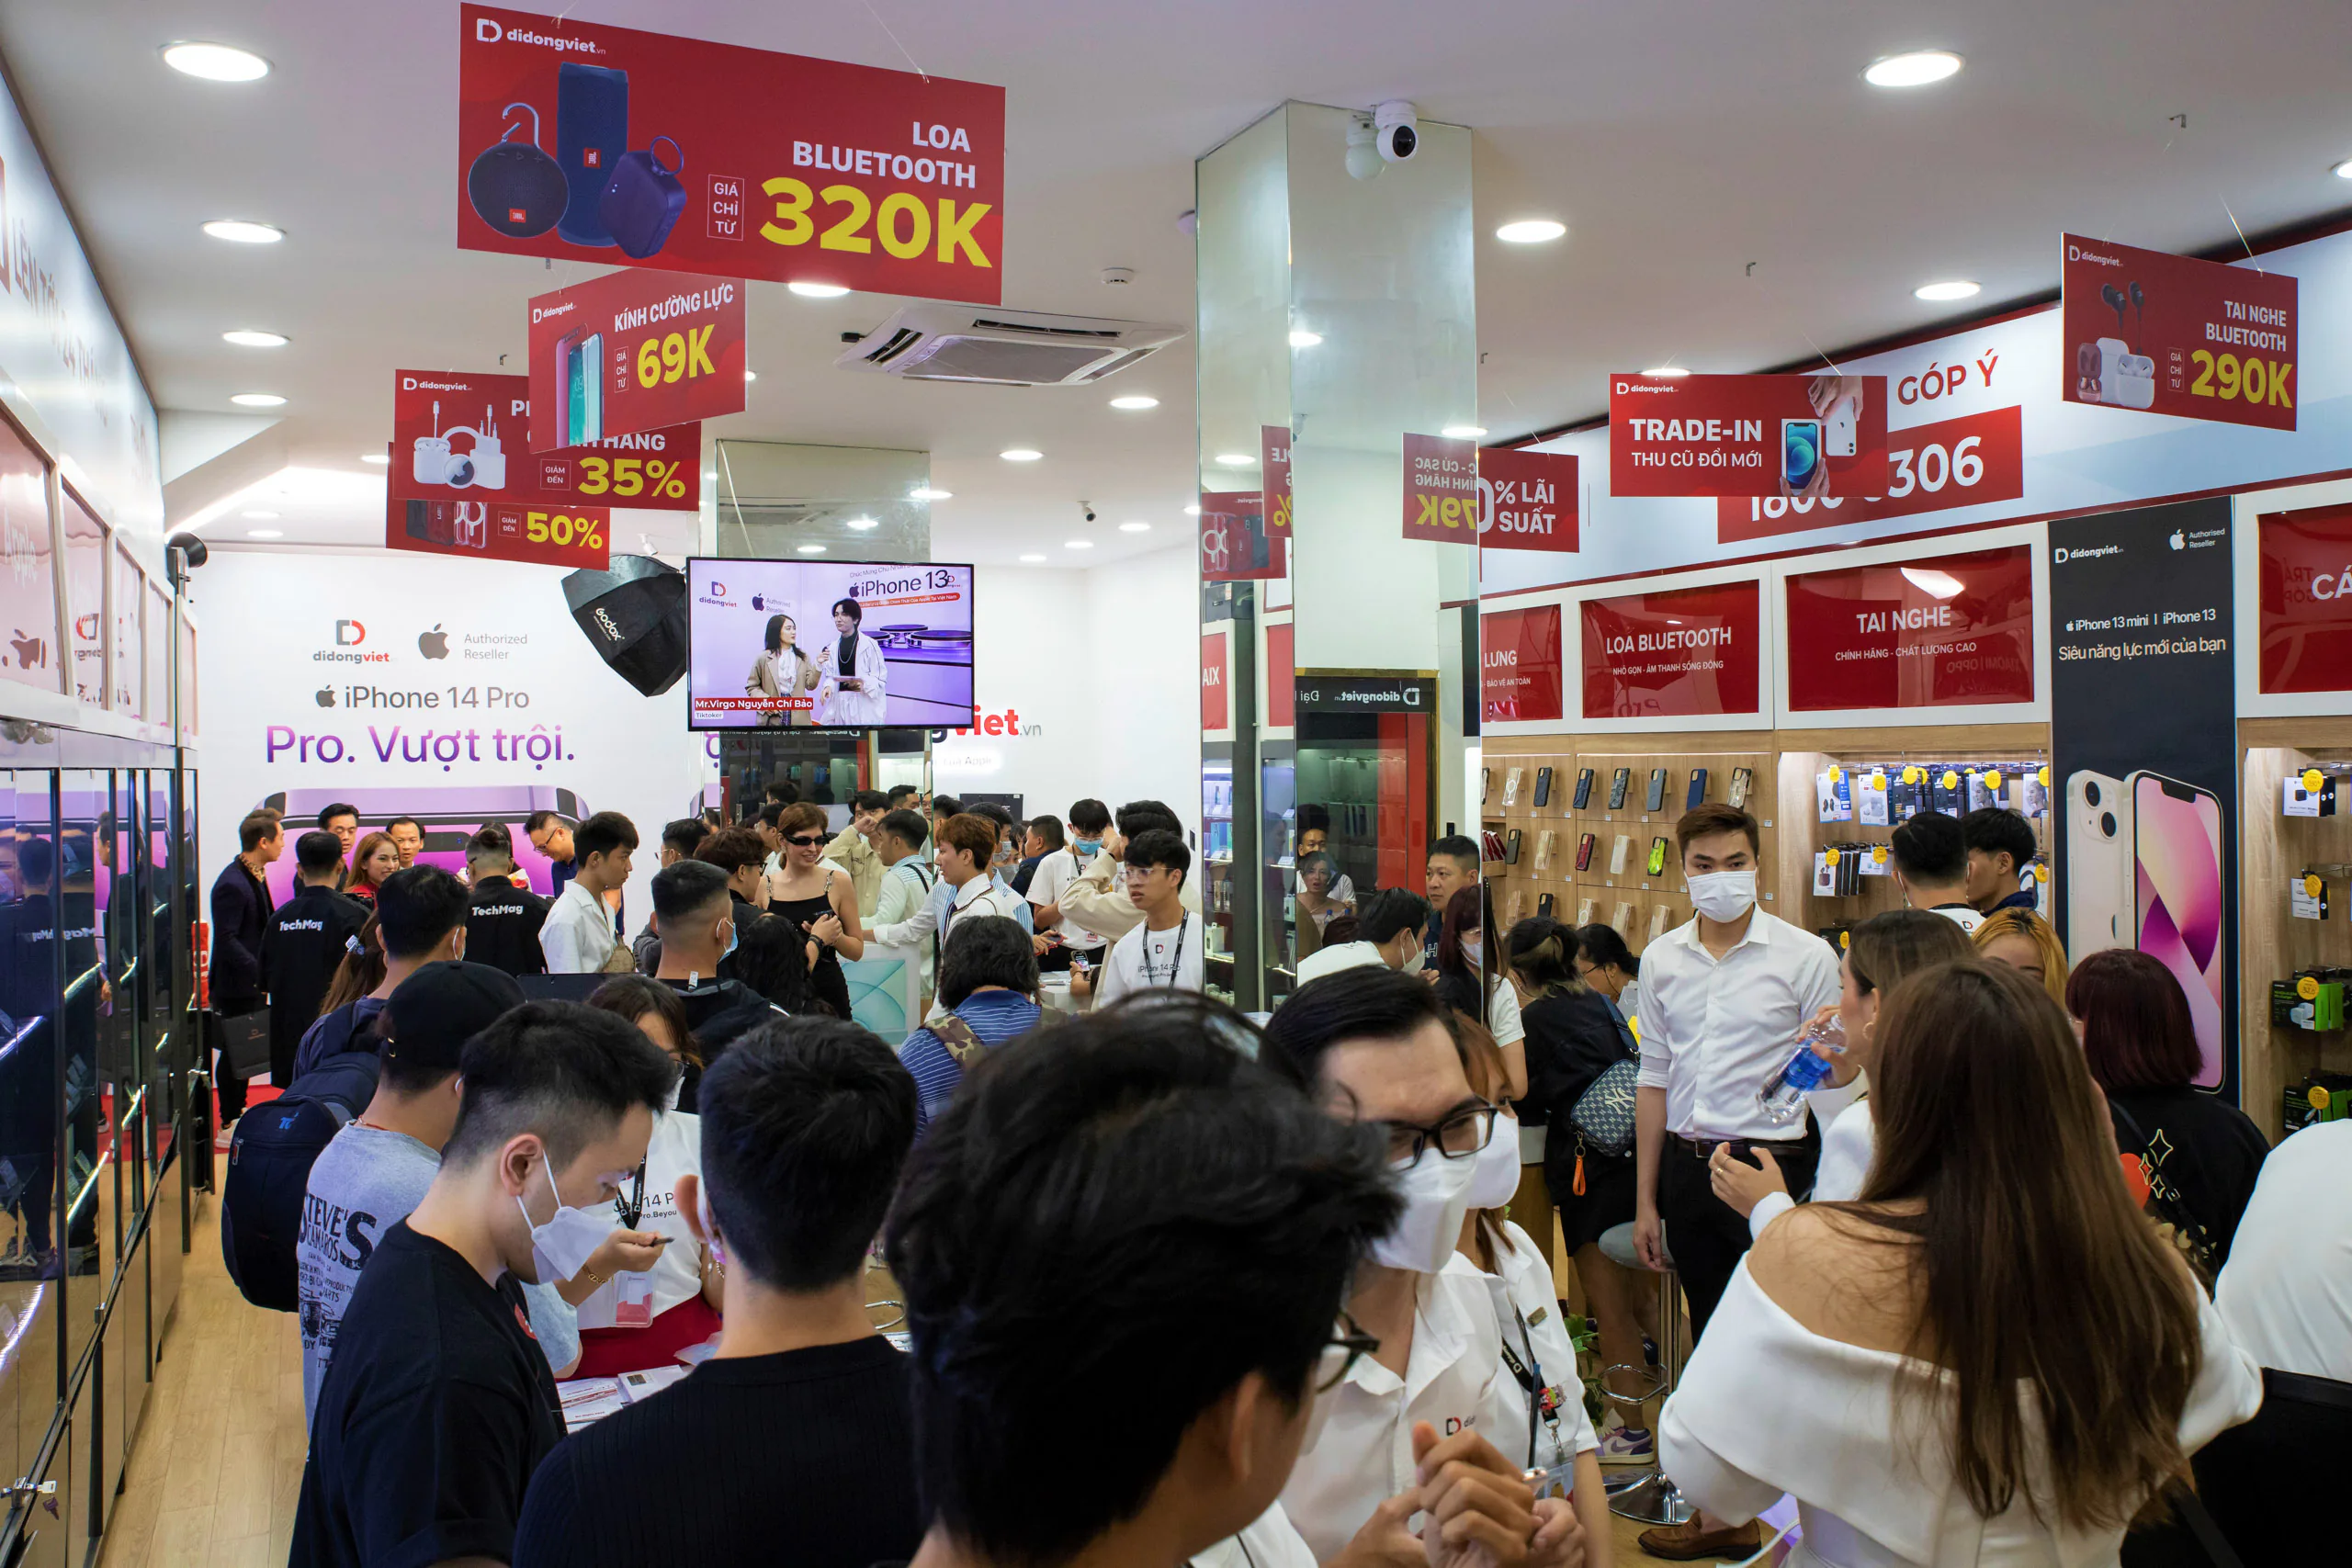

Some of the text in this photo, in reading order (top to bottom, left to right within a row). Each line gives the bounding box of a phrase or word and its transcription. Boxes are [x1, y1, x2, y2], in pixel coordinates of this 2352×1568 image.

[912, 121, 971, 152] LOA
[793, 141, 976, 189] BLUETOOTH
[714, 182, 739, 197] GIÁ
[713, 200, 739, 216] CHỈ
[715, 220, 737, 235] TỪ
[759, 176, 993, 268] 320K
[614, 283, 734, 333] KÍNH CƯỜNG LỰC
[2224, 300, 2287, 327] TAI NGHE
[2206, 321, 2287, 352] BLUETOOTH
[637, 323, 716, 389] 69K
[1897, 347, 2000, 406] GÓP Ý
[2191, 349, 2293, 409] 290K
[1629, 418, 1763, 443] TRADE-IN
[1632, 446, 1763, 468] THU CŨ ĐỔI MỚI
[1864, 435, 1984, 502] 306
[578, 457, 686, 499] 35%
[1521, 479, 1555, 504] LÃI
[526, 512, 604, 549] 50%
[1498, 506, 1555, 535] SUẤT
[2188, 528, 2226, 540] Authorised
[2188, 539, 2216, 549] Reseller
[861, 570, 949, 597] iPhone 13
[595, 607, 623, 641] Godox
[1856, 605, 1951, 634] TAI NGHE
[2075, 608, 2216, 631] iPhone 13 mini iPhone 13
[464, 634, 527, 645] Authorized
[1606, 626, 1732, 655] LOA BLUETOOTH
[1835, 649, 1862, 661] CHÍNH
[1863, 646, 1889, 660] HÃNG
[1895, 644, 1920, 658] CHẤT
[1921, 643, 1953, 657] LƯỢNG
[1955, 642, 1977, 654] CAO
[2058, 636, 2226, 661] Siêu năng lực mới của bạn
[464, 649, 510, 660] Reseller
[1484, 649, 1517, 669] LƯNG
[1612, 665, 1627, 676] NHỎ
[1628, 664, 1642, 678] GỌN
[1645, 662, 1657, 674] ÂM
[1657, 662, 1680, 673] THANH
[1681, 659, 1702, 671] SỐNG
[1702, 659, 1724, 671] ĐỘNG
[1498, 678, 1507, 688] VỆ
[1507, 678, 1514, 686] AN
[1515, 676, 1531, 686] TOÀN
[345, 685, 530, 708] iPhone 14 Pro
[695, 699, 813, 710] Mr.Virgo Nguyễn Chí Bảo
[266, 723, 575, 772] Pro. Vượt trội.
[471, 905, 524, 916] TechMag
[279, 919, 323, 931] TechMag
[643, 1194, 662, 1208] 14
